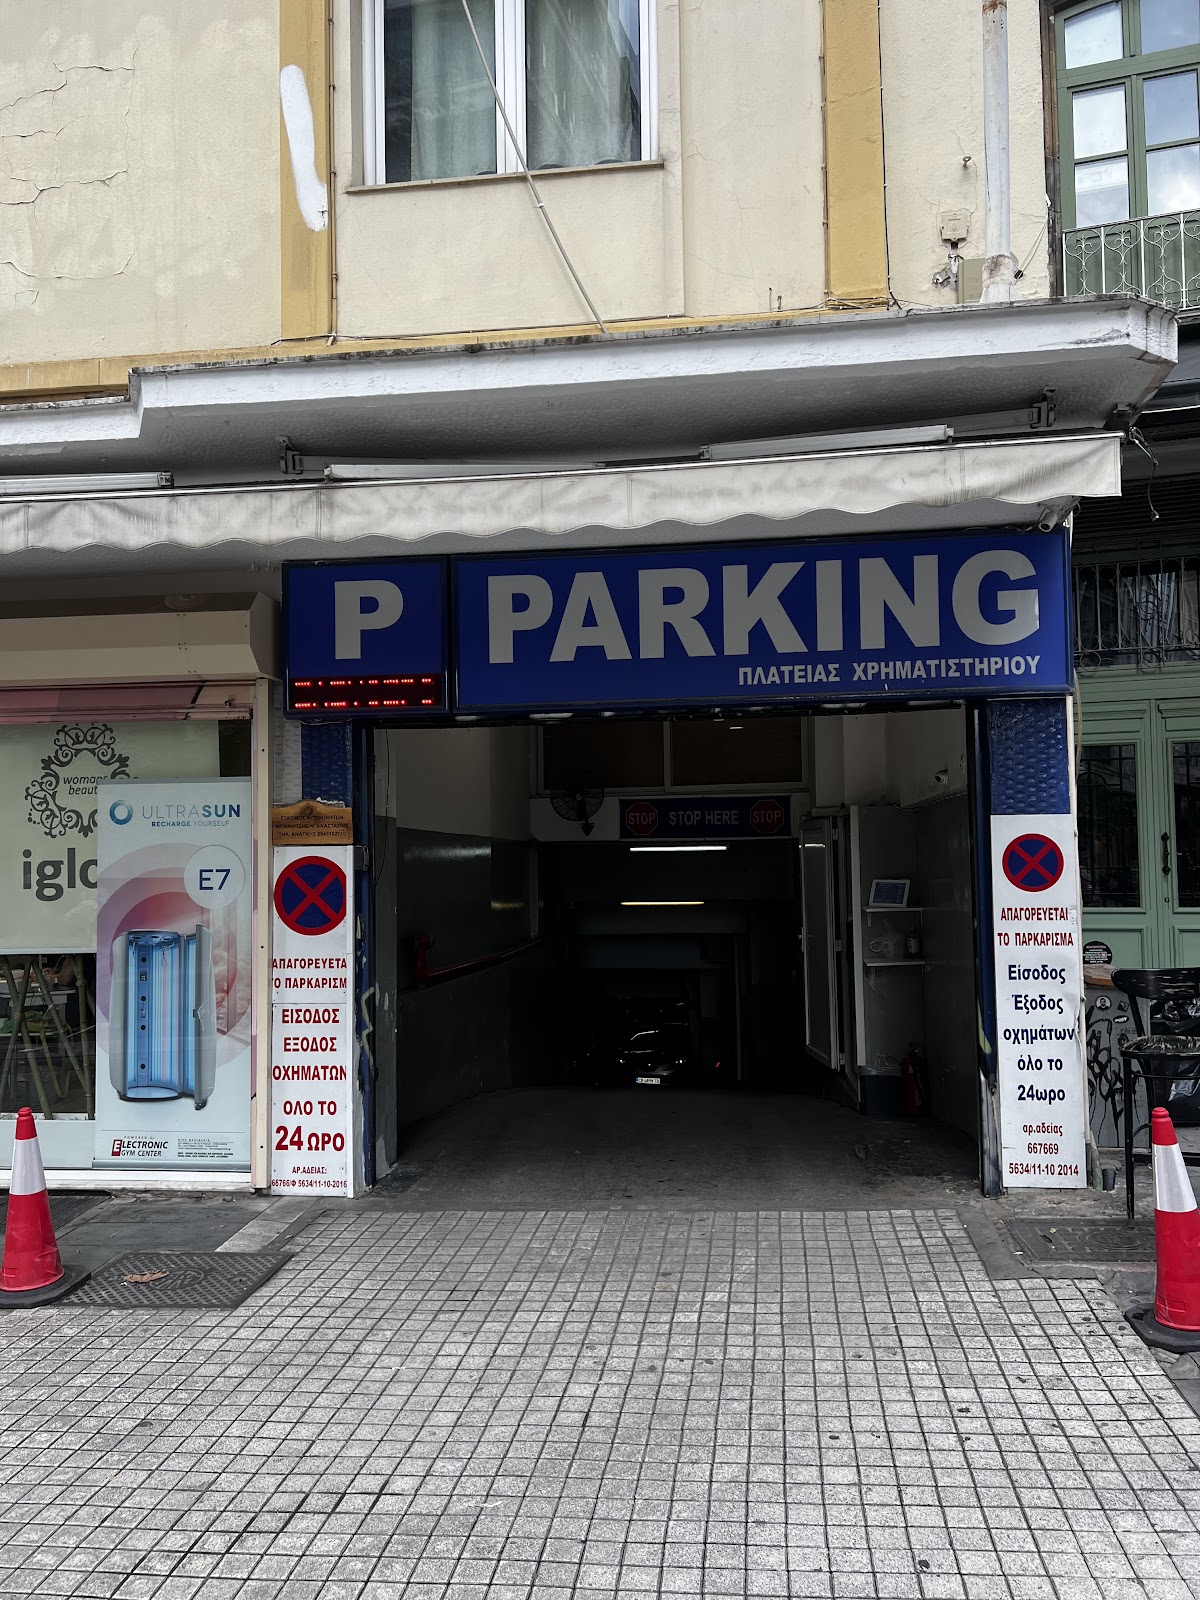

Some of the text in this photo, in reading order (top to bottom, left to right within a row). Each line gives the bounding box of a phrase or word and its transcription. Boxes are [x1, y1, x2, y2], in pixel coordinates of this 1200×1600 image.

[487, 549, 1041, 665] PARKING
[334, 579, 404, 660] P
[738, 655, 1041, 686] ΠΛΑΤΕΙΑΣ ΧΡΗΜΑΤΙΣΤΗΡΙΟΥ
[142, 804, 241, 820] ULTRASUN
[628, 812, 656, 825] STOP
[668, 810, 739, 825] STOP HERE
[752, 810, 782, 823] STOP
[199, 868, 231, 891] E7
[1000, 907, 1069, 921] ΑΠΑΓΟΡΕΥΕΤΑΙ
[997, 932, 1074, 947] ΤΟ ΠΑΡΚΑΡΙΣΜΑ
[1007, 964, 1066, 985] Είσοδος
[1011, 994, 1064, 1015] Έξοδος
[281, 1008, 340, 1024] ΕΙΣΟΔΟΣ
[1003, 1025, 1075, 1045] οχημάτων
[283, 1037, 337, 1052] ΕΞΟΔΟΣ
[1017, 1054, 1063, 1071] όλο το
[272, 1065, 347, 1081] ΟΧΗΜΑΤΩΝ
[1017, 1084, 1066, 1106] 24ωρο
[283, 1100, 337, 1116] ΟΛΟ ΤΟ
[1022, 1122, 1063, 1137] αρ.αδείας
[111, 1139, 169, 1152] ELECTRONIC
[275, 1125, 345, 1152] 24 ΩΡΟ
[121, 1149, 162, 1157] GYM CENTER
[1027, 1142, 1059, 1155] 667669
[1008, 1162, 1079, 1176] 5634/11-10 2014
